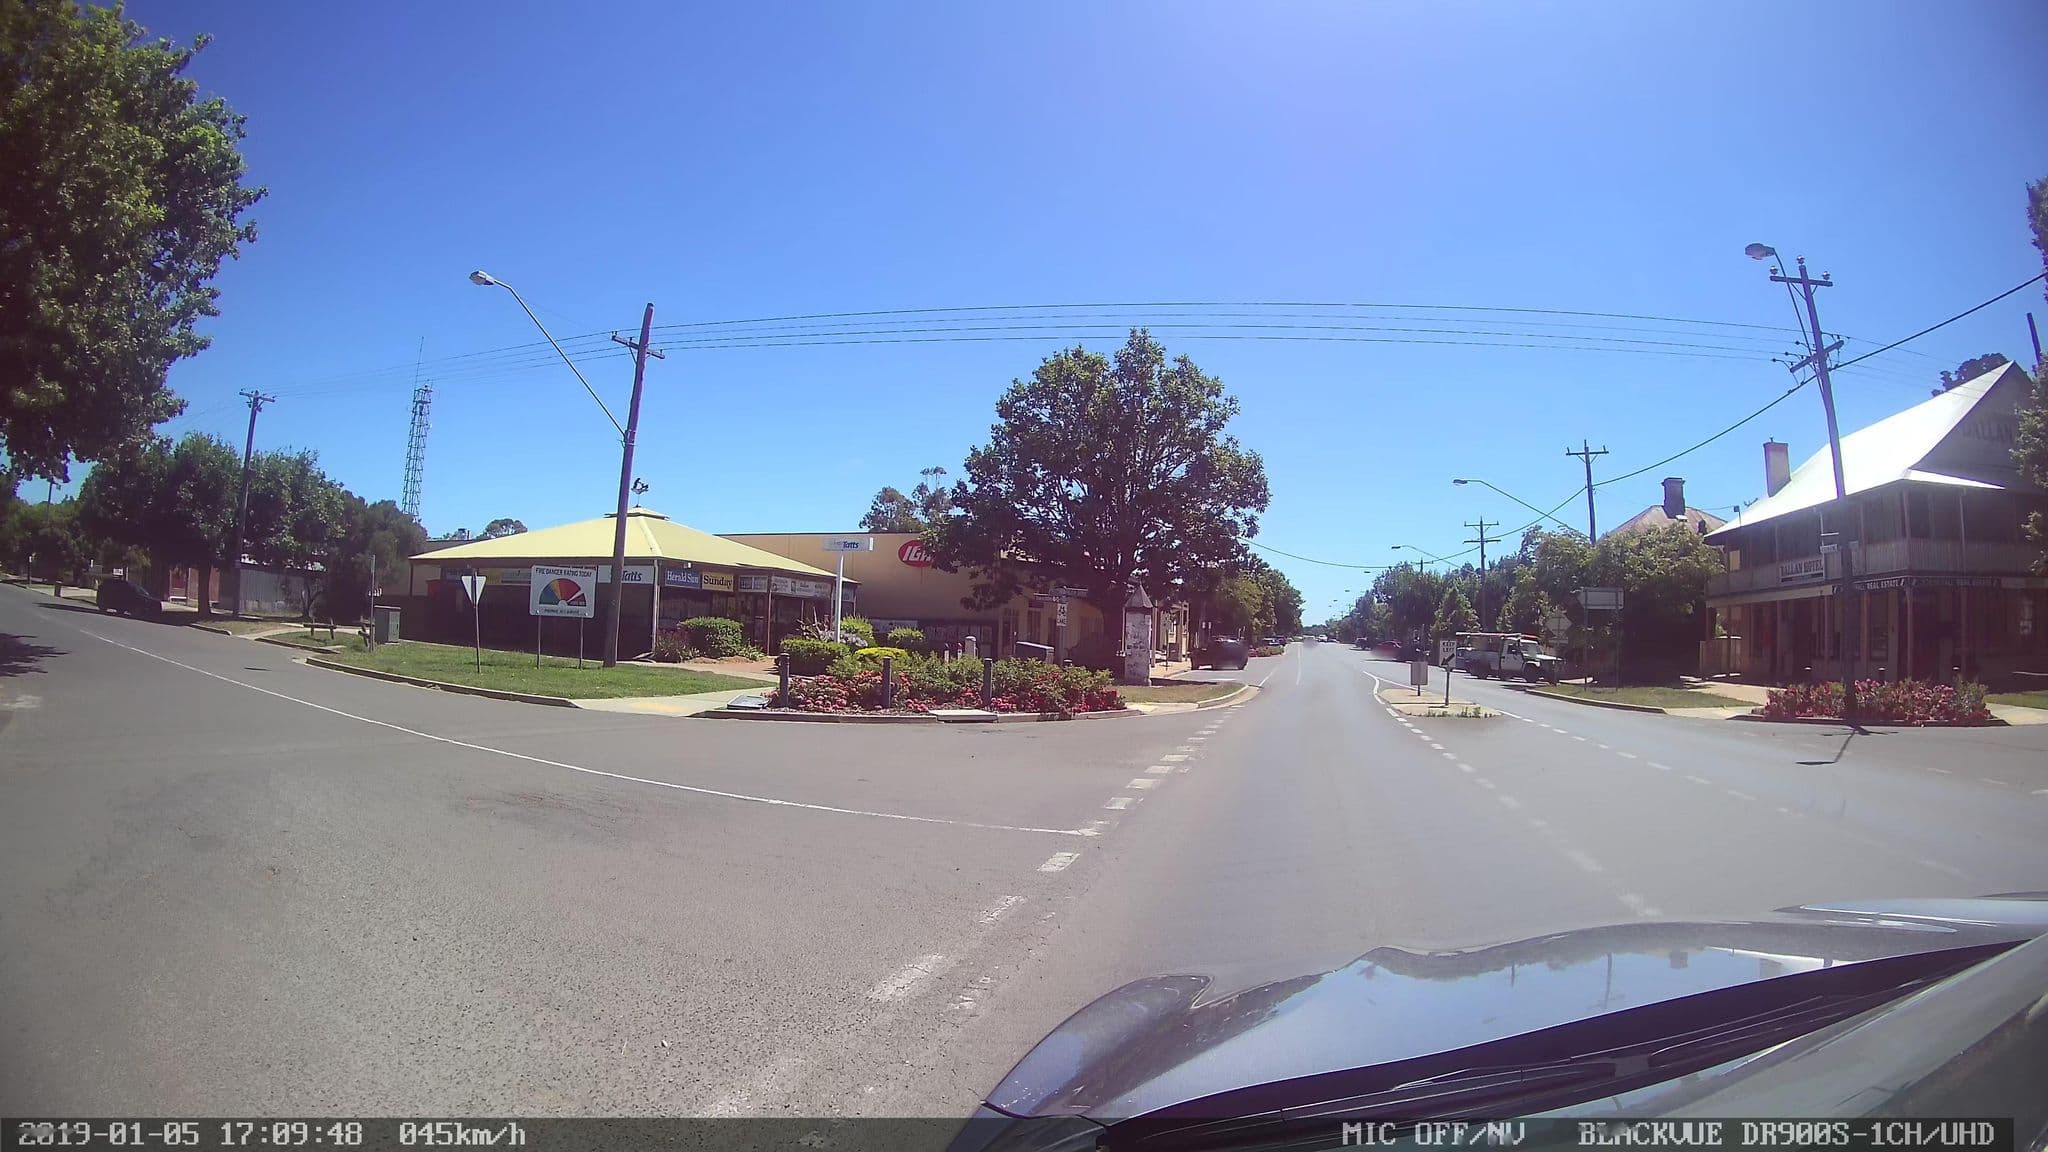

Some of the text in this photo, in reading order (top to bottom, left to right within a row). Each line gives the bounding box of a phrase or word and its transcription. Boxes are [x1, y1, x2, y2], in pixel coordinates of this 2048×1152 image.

[545, 568, 563, 576] DANGER
[563, 569, 578, 577] RATING
[622, 570, 642, 582] Tatts
[667, 570, 699, 584] Herald Sun
[703, 574, 732, 589] Sunday
[1881, 579, 1900, 588] ESTATE
